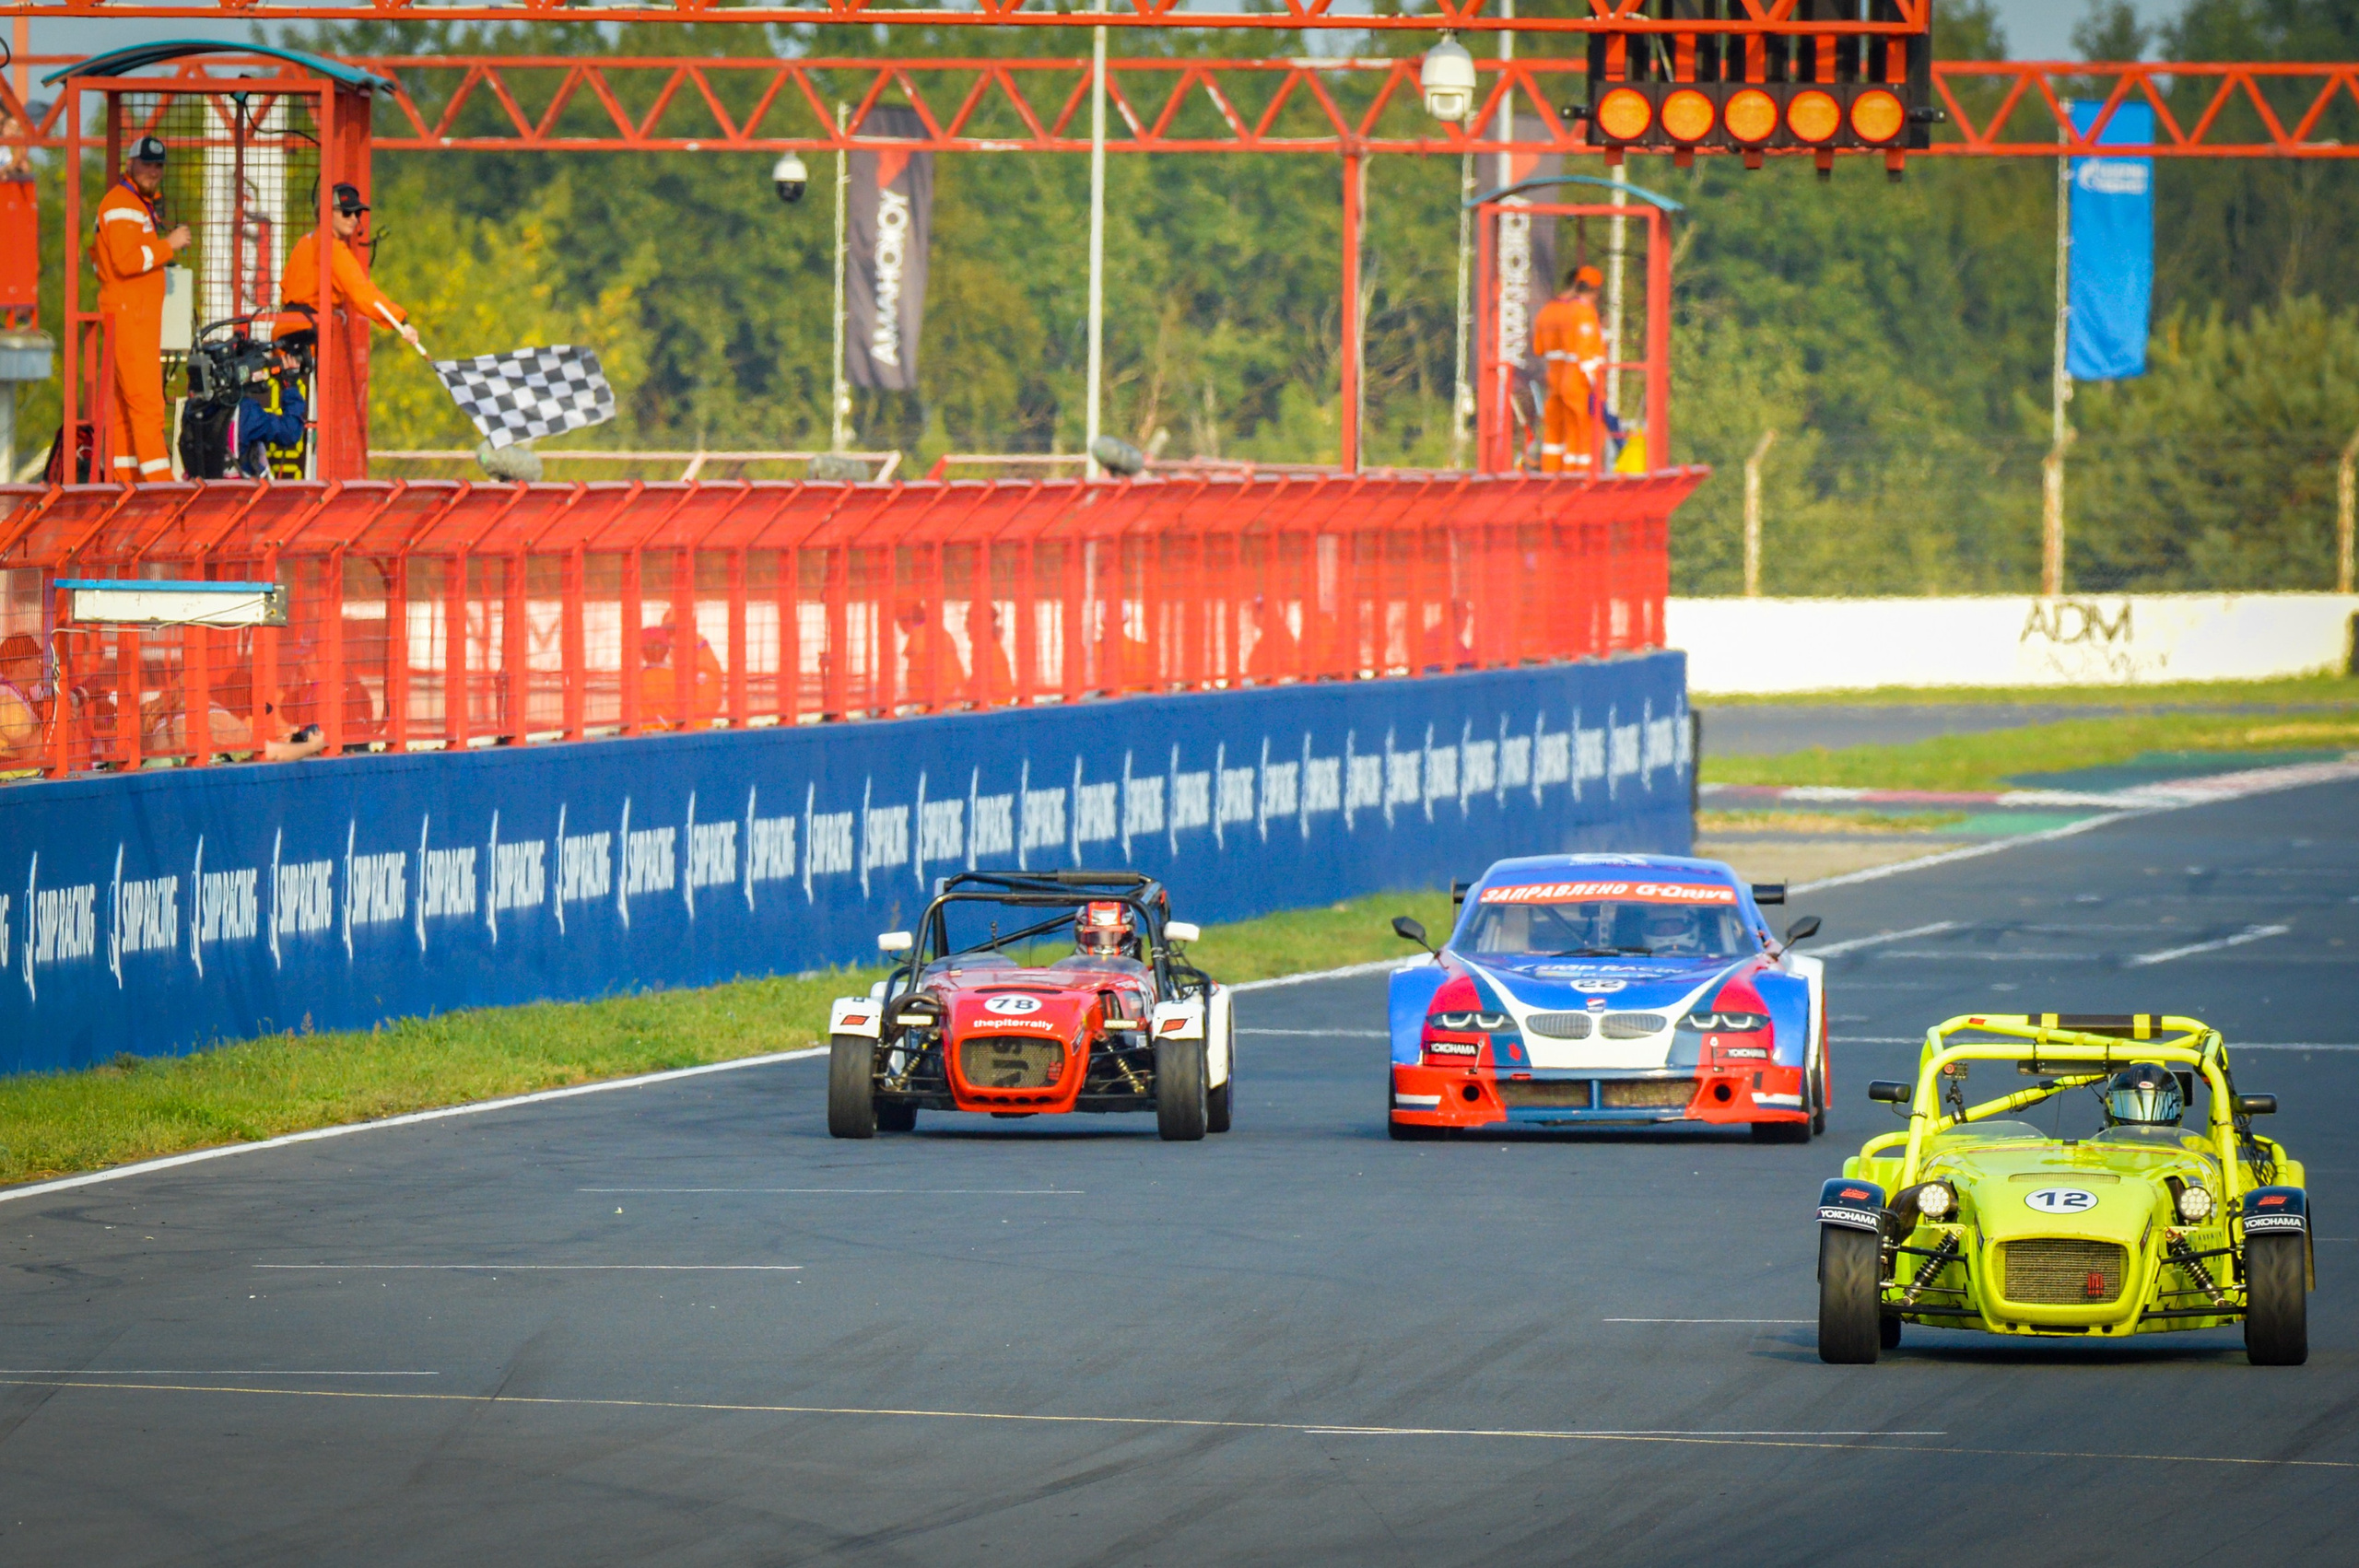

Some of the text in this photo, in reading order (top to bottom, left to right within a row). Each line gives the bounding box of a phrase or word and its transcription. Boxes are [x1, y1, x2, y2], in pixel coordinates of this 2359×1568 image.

[2019, 598, 2134, 644] ADM
[1480, 883, 1628, 903] ЗАПРАВЛЕНО
[36, 890, 58, 963] SMP
[57, 883, 95, 960] RACING
[992, 999, 1034, 1010] 78
[1430, 1043, 1476, 1055] YOKOHAMA
[2036, 1191, 2089, 1208] 12
[1820, 1210, 1877, 1227] YOKOHAMA
[2244, 1217, 2302, 1229] YOKOHAMA
